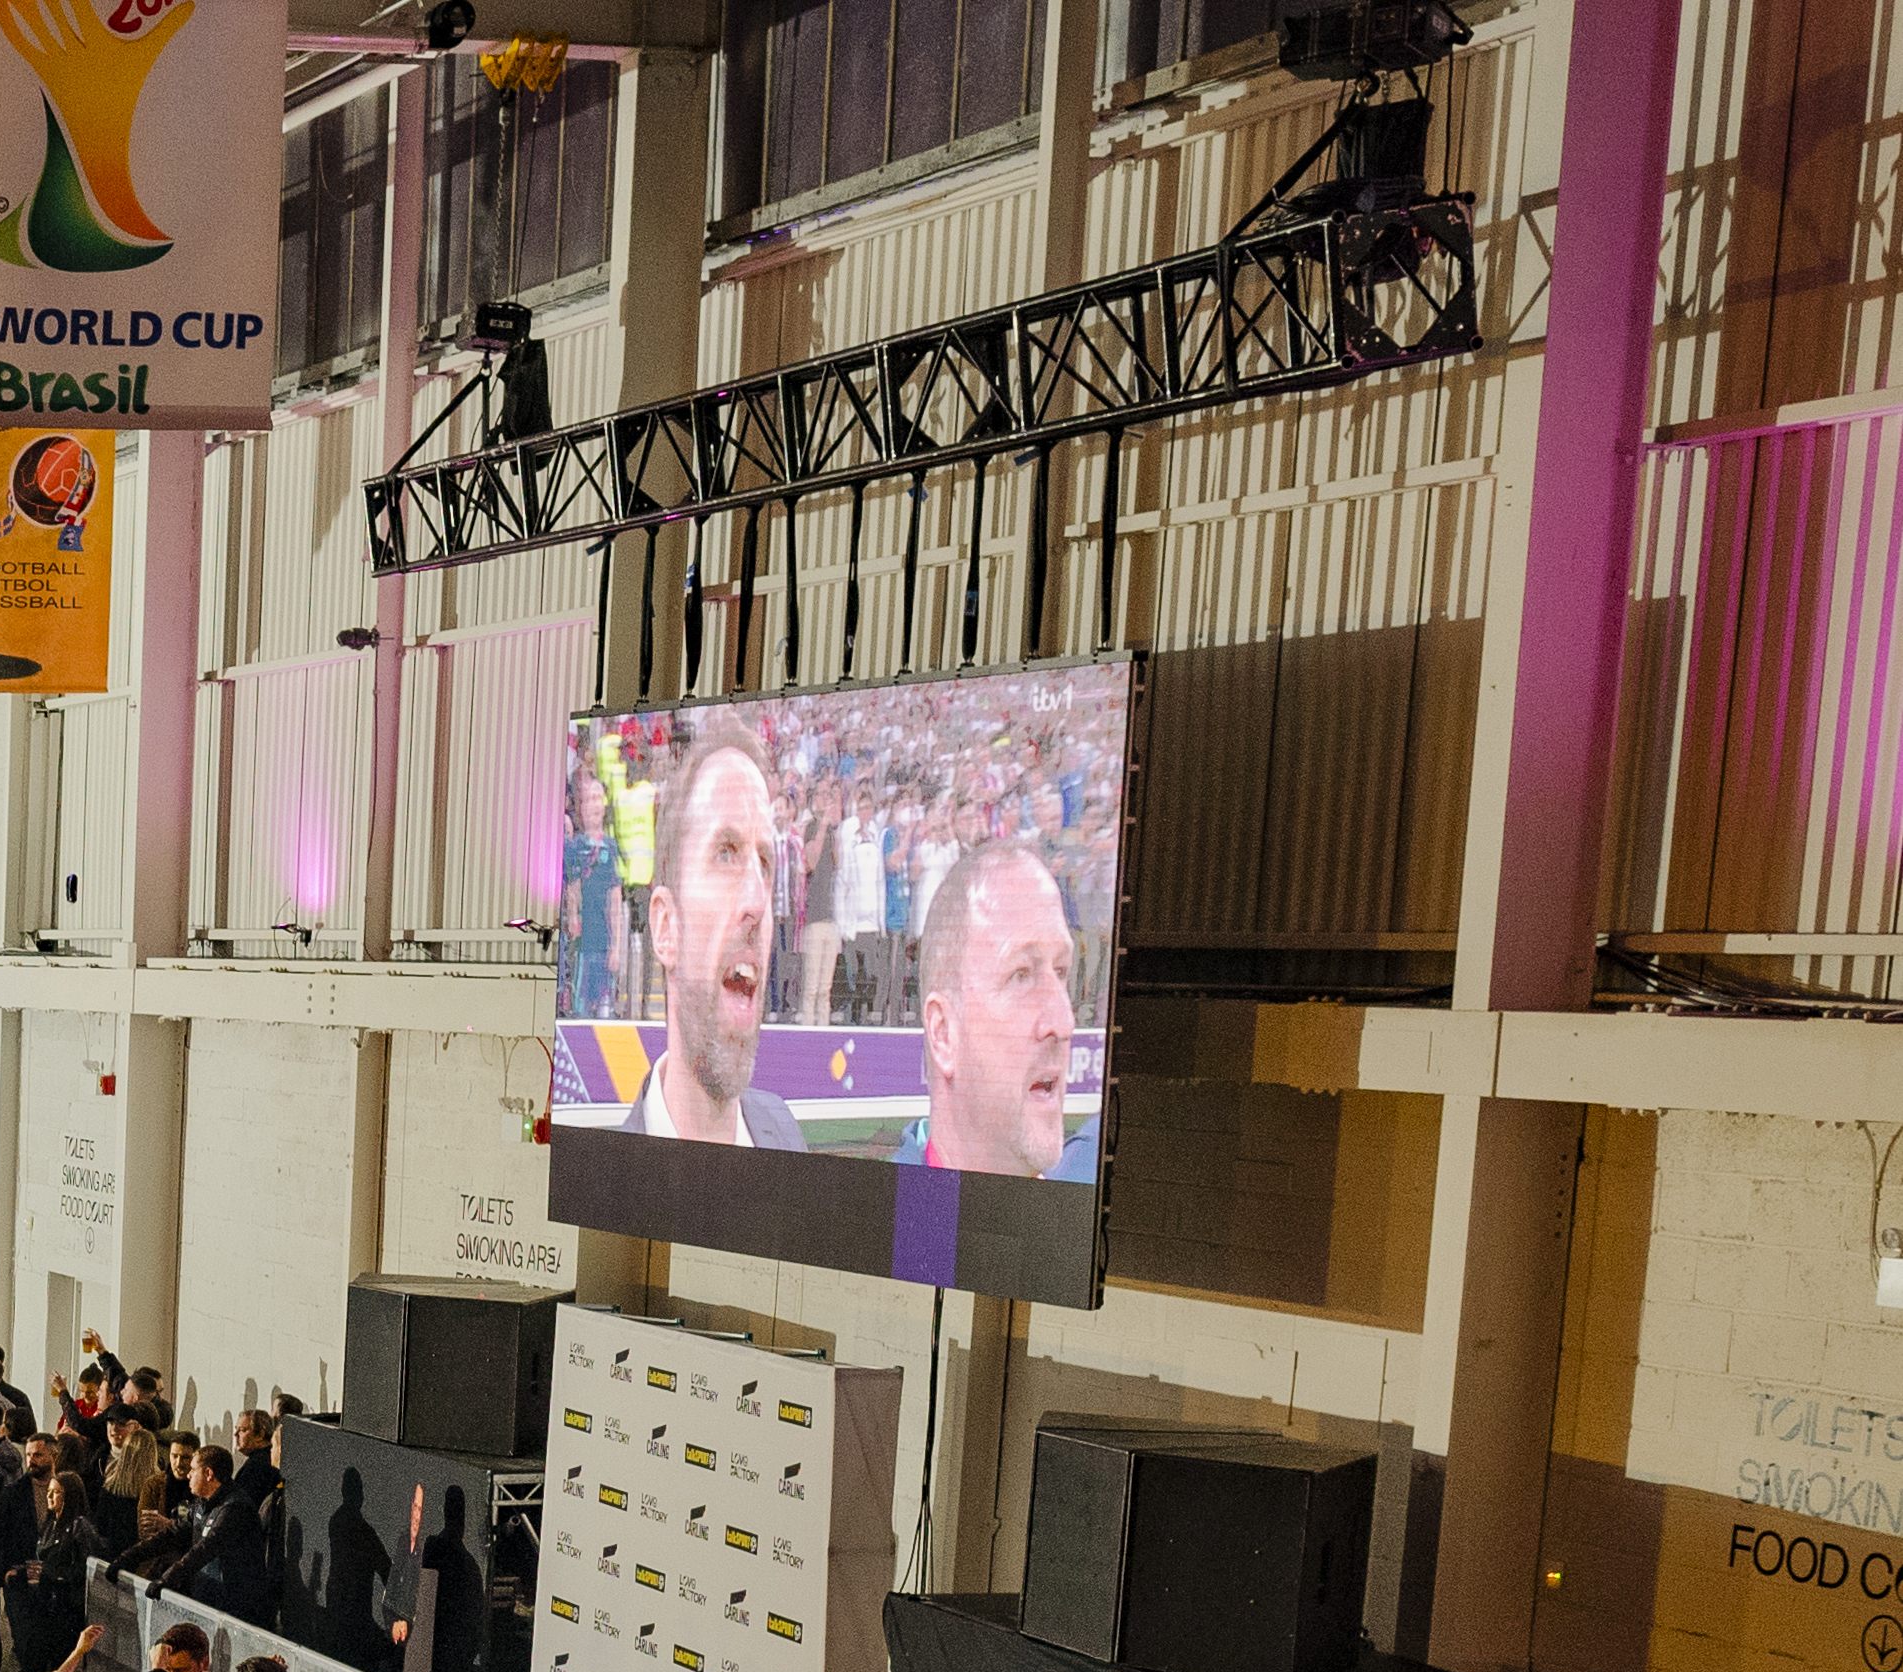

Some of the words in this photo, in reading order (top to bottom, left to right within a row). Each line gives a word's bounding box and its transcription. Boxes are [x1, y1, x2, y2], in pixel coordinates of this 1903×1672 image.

[172, 310, 264, 350] CUP
[60, 1195, 84, 1219] FOOD
[460, 1194, 514, 1227] TOILETS
[456, 1233, 524, 1269] SMOKING
[1729, 1523, 1850, 1589] FOOD
